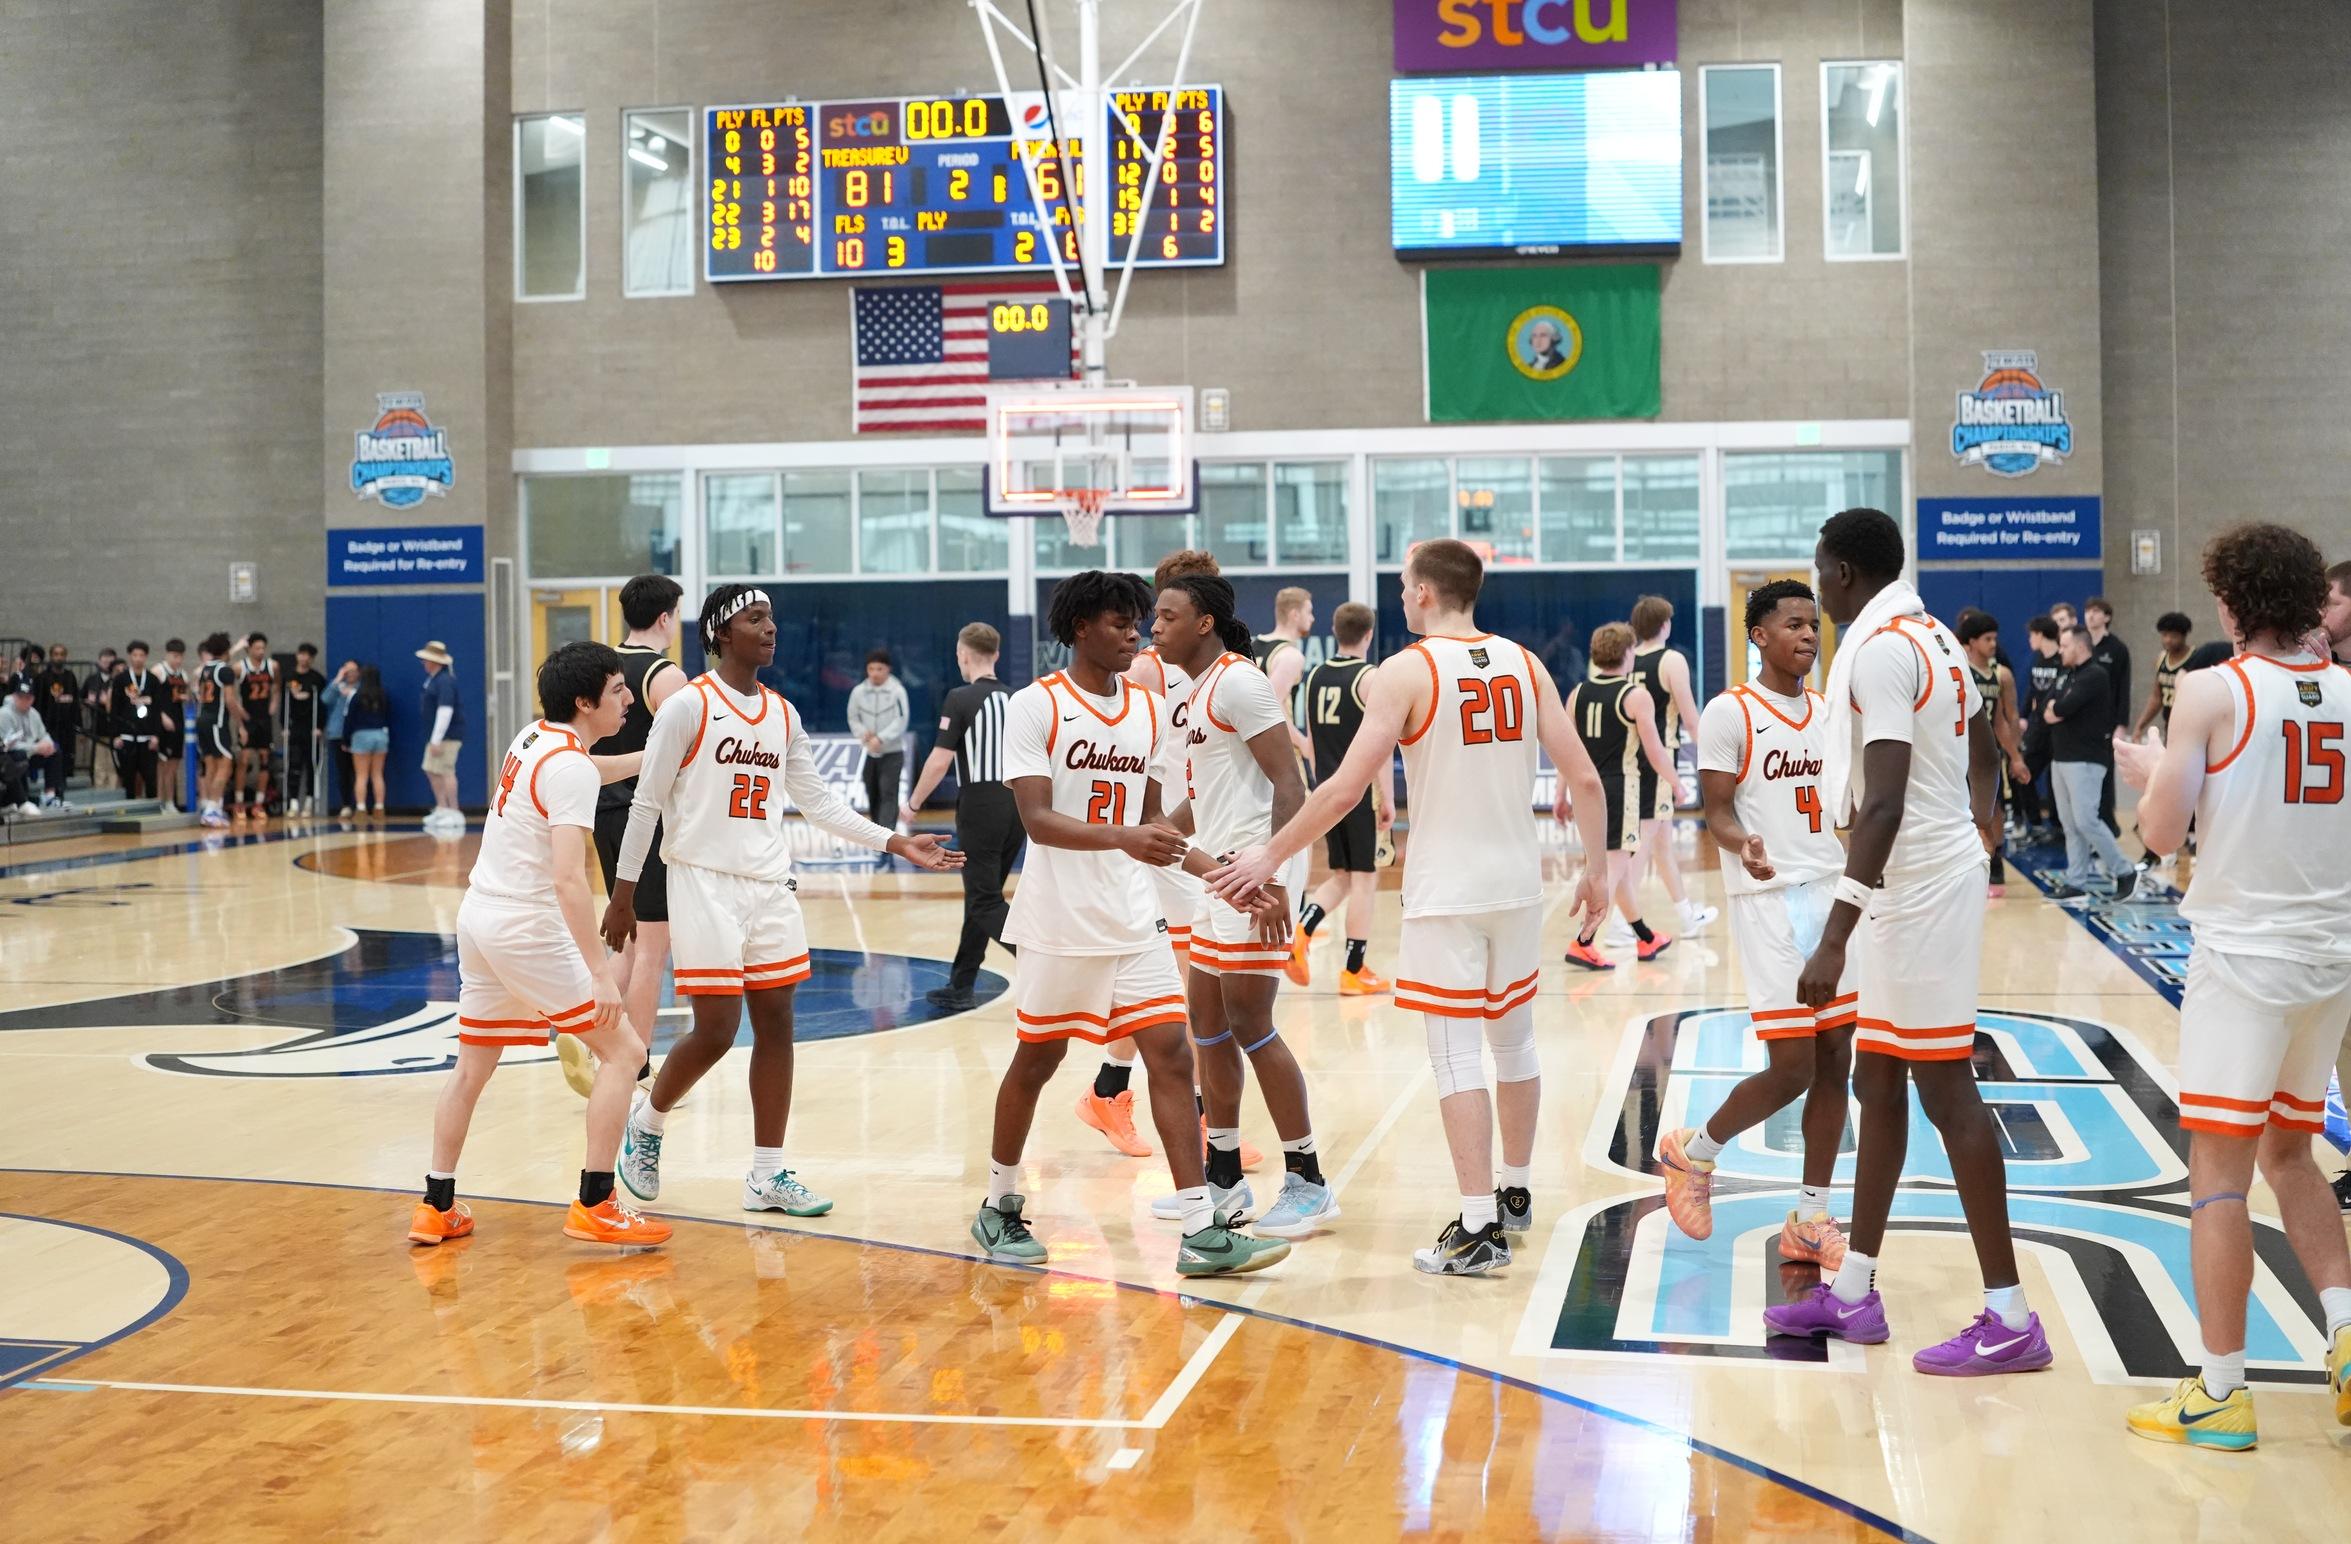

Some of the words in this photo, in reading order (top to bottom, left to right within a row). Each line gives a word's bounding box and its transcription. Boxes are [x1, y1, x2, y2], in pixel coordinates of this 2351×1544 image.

[1437, 0, 1628, 47] stcu
[1116, 92, 1146, 112] PLY
[1176, 89, 1208, 110] PTS
[716, 111, 746, 129] PLY
[751, 109, 771, 128] FL
[774, 107, 805, 127] PTS
[830, 111, 890, 137] stcu
[907, 99, 987, 139] 00.0
[1198, 110, 1214, 133] 6
[795, 127, 810, 149] 5
[1199, 135, 1214, 158] 5
[725, 156, 741, 175] 4
[762, 152, 775, 175] 3
[795, 151, 810, 174] 2
[1118, 162, 1141, 186] 12
[1162, 161, 1178, 184] 0
[1199, 160, 1214, 183] 0
[789, 175, 810, 197] 10
[949, 169, 969, 201] 2
[1199, 186, 1214, 206] 4
[711, 202, 741, 226] 22
[762, 200, 776, 224] 3
[835, 214, 865, 234] FLS
[917, 210, 948, 231] PLY
[1200, 209, 1215, 233] 2
[711, 226, 741, 250] 23
[760, 225, 776, 248] 2
[796, 225, 810, 244] 4
[1015, 231, 1034, 263] 2
[1163, 235, 1178, 258] 6
[837, 238, 864, 268] 10
[887, 236, 906, 267] 3
[993, 304, 1048, 332] 00.0
[1960, 393, 2065, 425] BASKETBALL
[360, 431, 449, 463] BASKETBALL
[1941, 510, 1986, 527] Badge
[1987, 512, 2004, 525] or
[2005, 508, 2076, 524] Wristband
[347, 540, 386, 555] Badge
[386, 541, 401, 553] or
[401, 537, 463, 552] Wristband
[1936, 530, 1998, 547] Required
[2000, 529, 2020, 544] for
[2022, 529, 2081, 546] Re-entry
[343, 558, 396, 574] Required
[397, 557, 415, 571] for
[416, 557, 468, 572] Re-entry
[1317, 686, 1342, 725] 12
[1457, 674, 1524, 745] 20
[1586, 702, 1603, 739] 11
[715, 736, 781, 769] Chukars
[1065, 739, 1146, 775] Chukars
[2282, 719, 2346, 804] 15
[728, 773, 771, 820] 22
[1086, 779, 1127, 826] 21
[1795, 785, 1824, 834] 4
